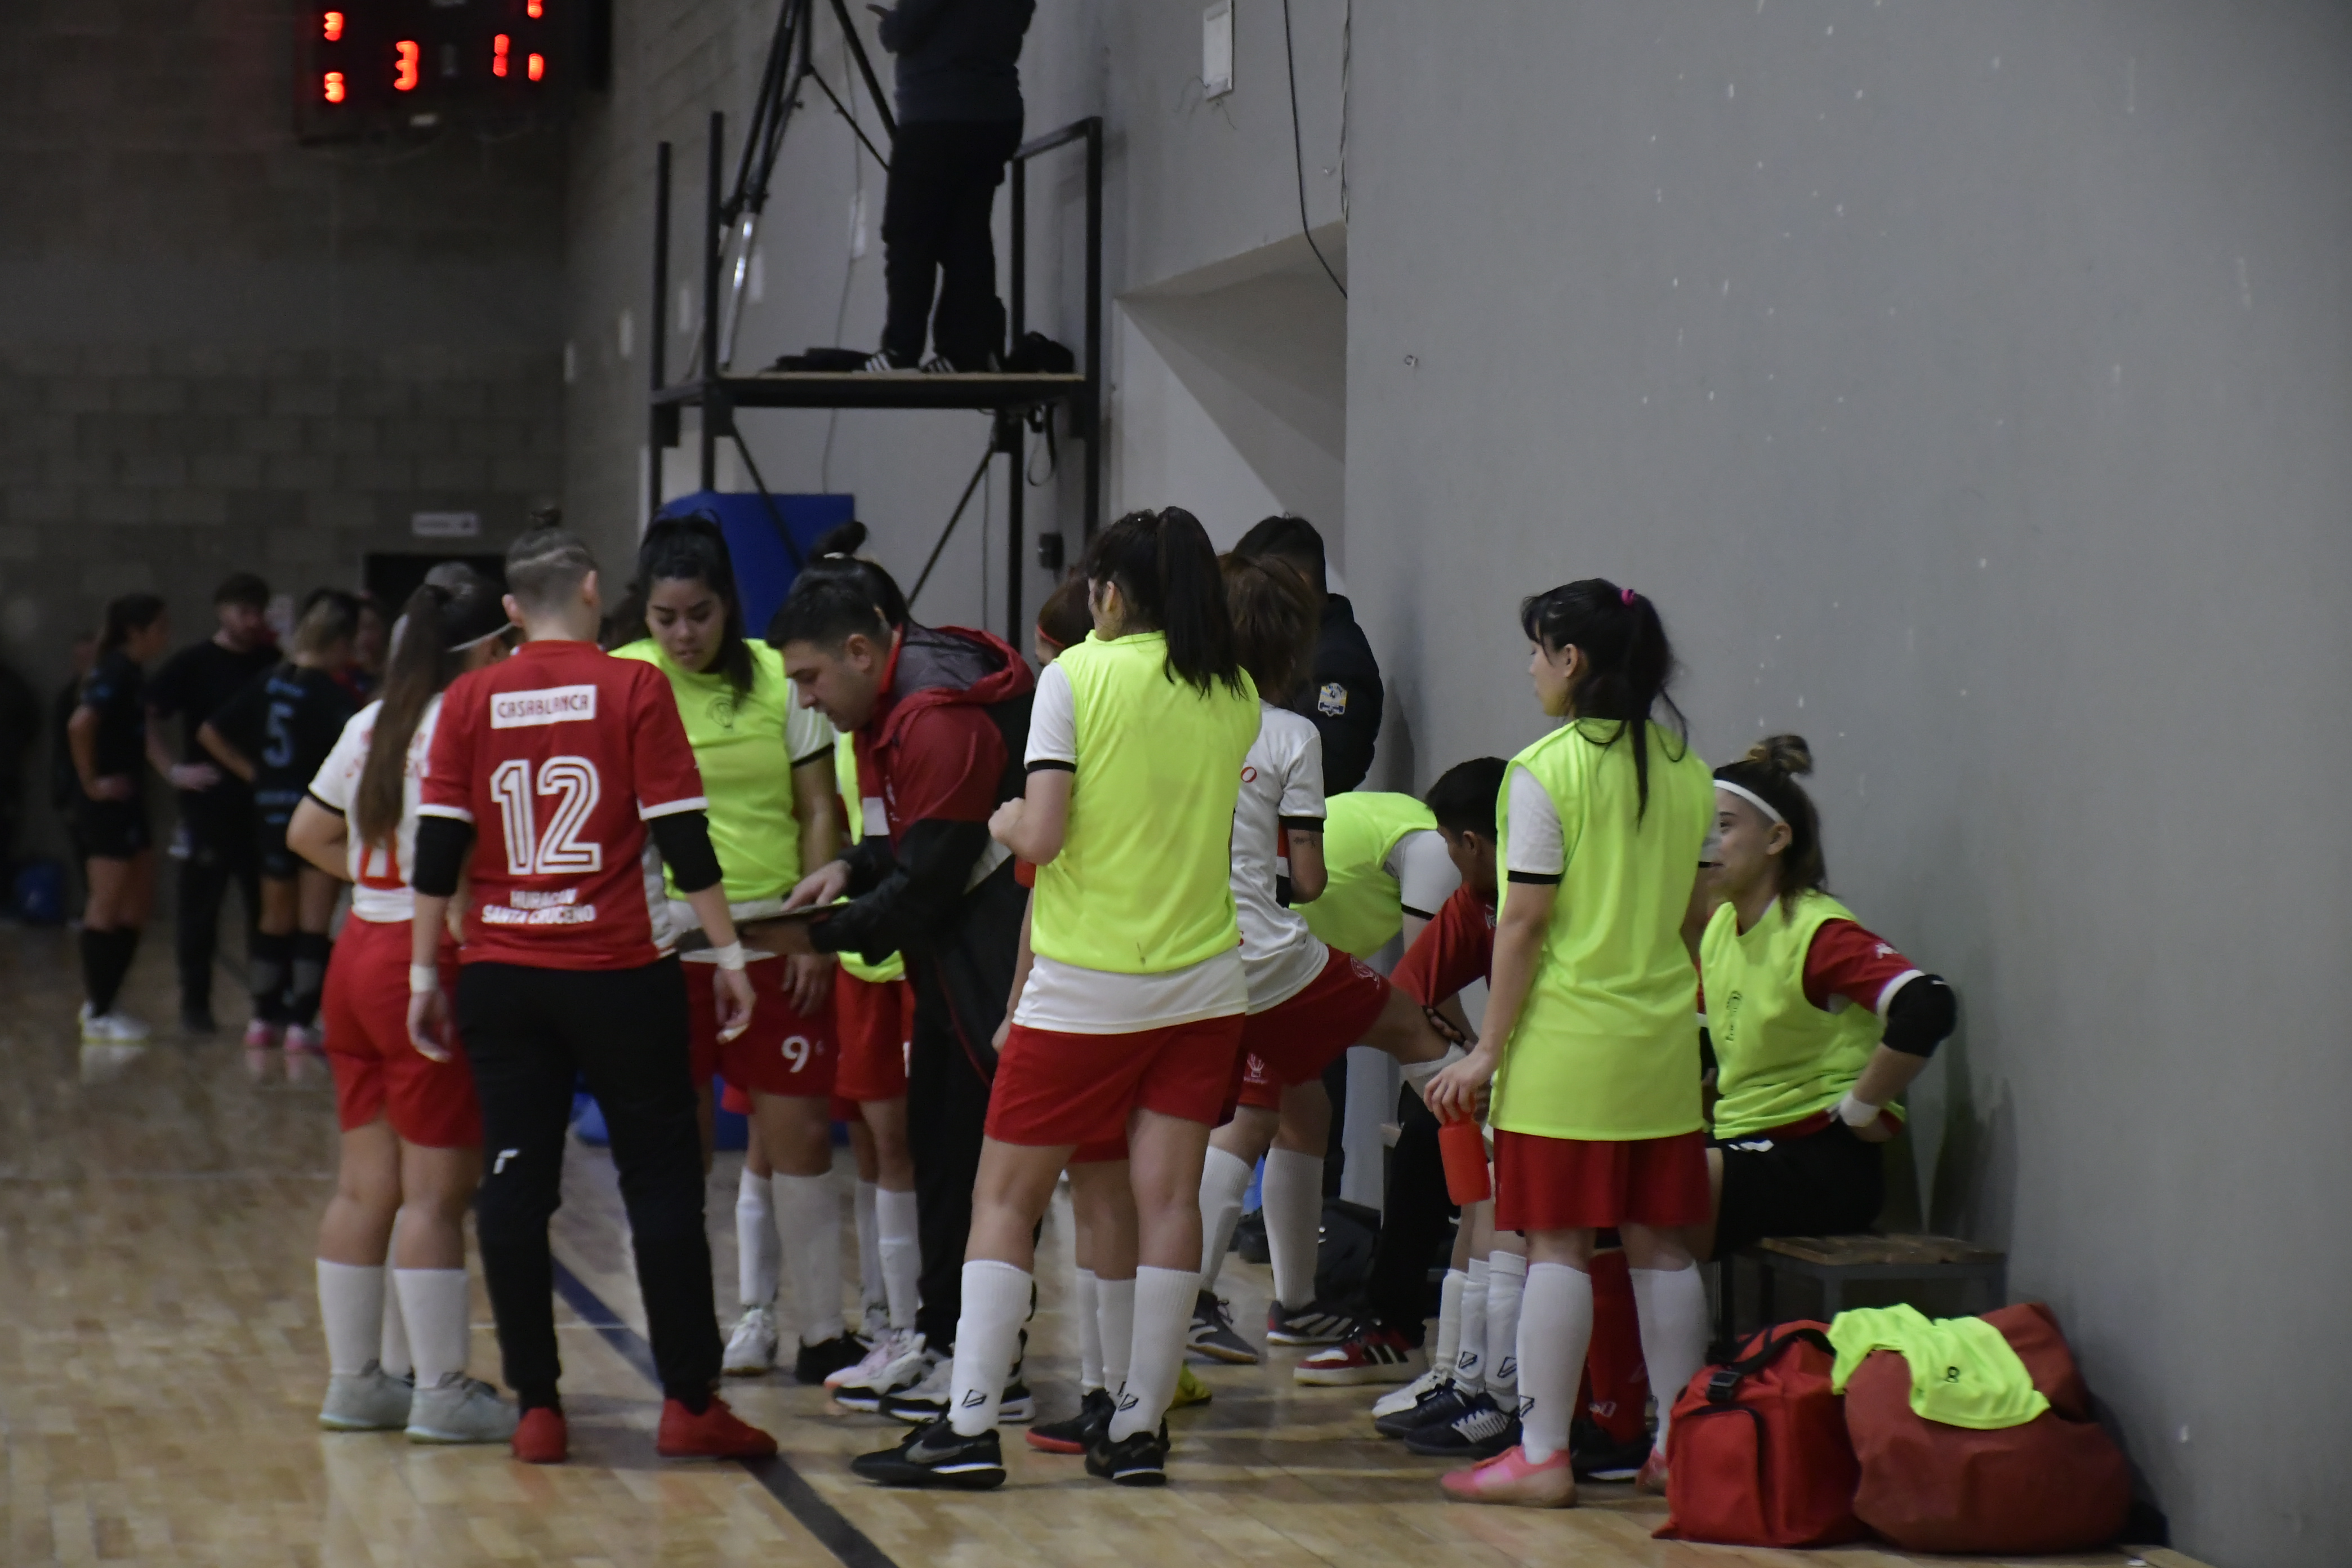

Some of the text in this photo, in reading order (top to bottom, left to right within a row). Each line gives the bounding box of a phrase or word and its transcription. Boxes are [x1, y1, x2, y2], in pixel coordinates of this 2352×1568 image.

[394, 40, 418, 91] 3
[498, 694, 589, 719] CASABLANCA
[262, 702, 295, 768] 5
[489, 755, 603, 875] 12
[781, 1035, 810, 1073] 9
